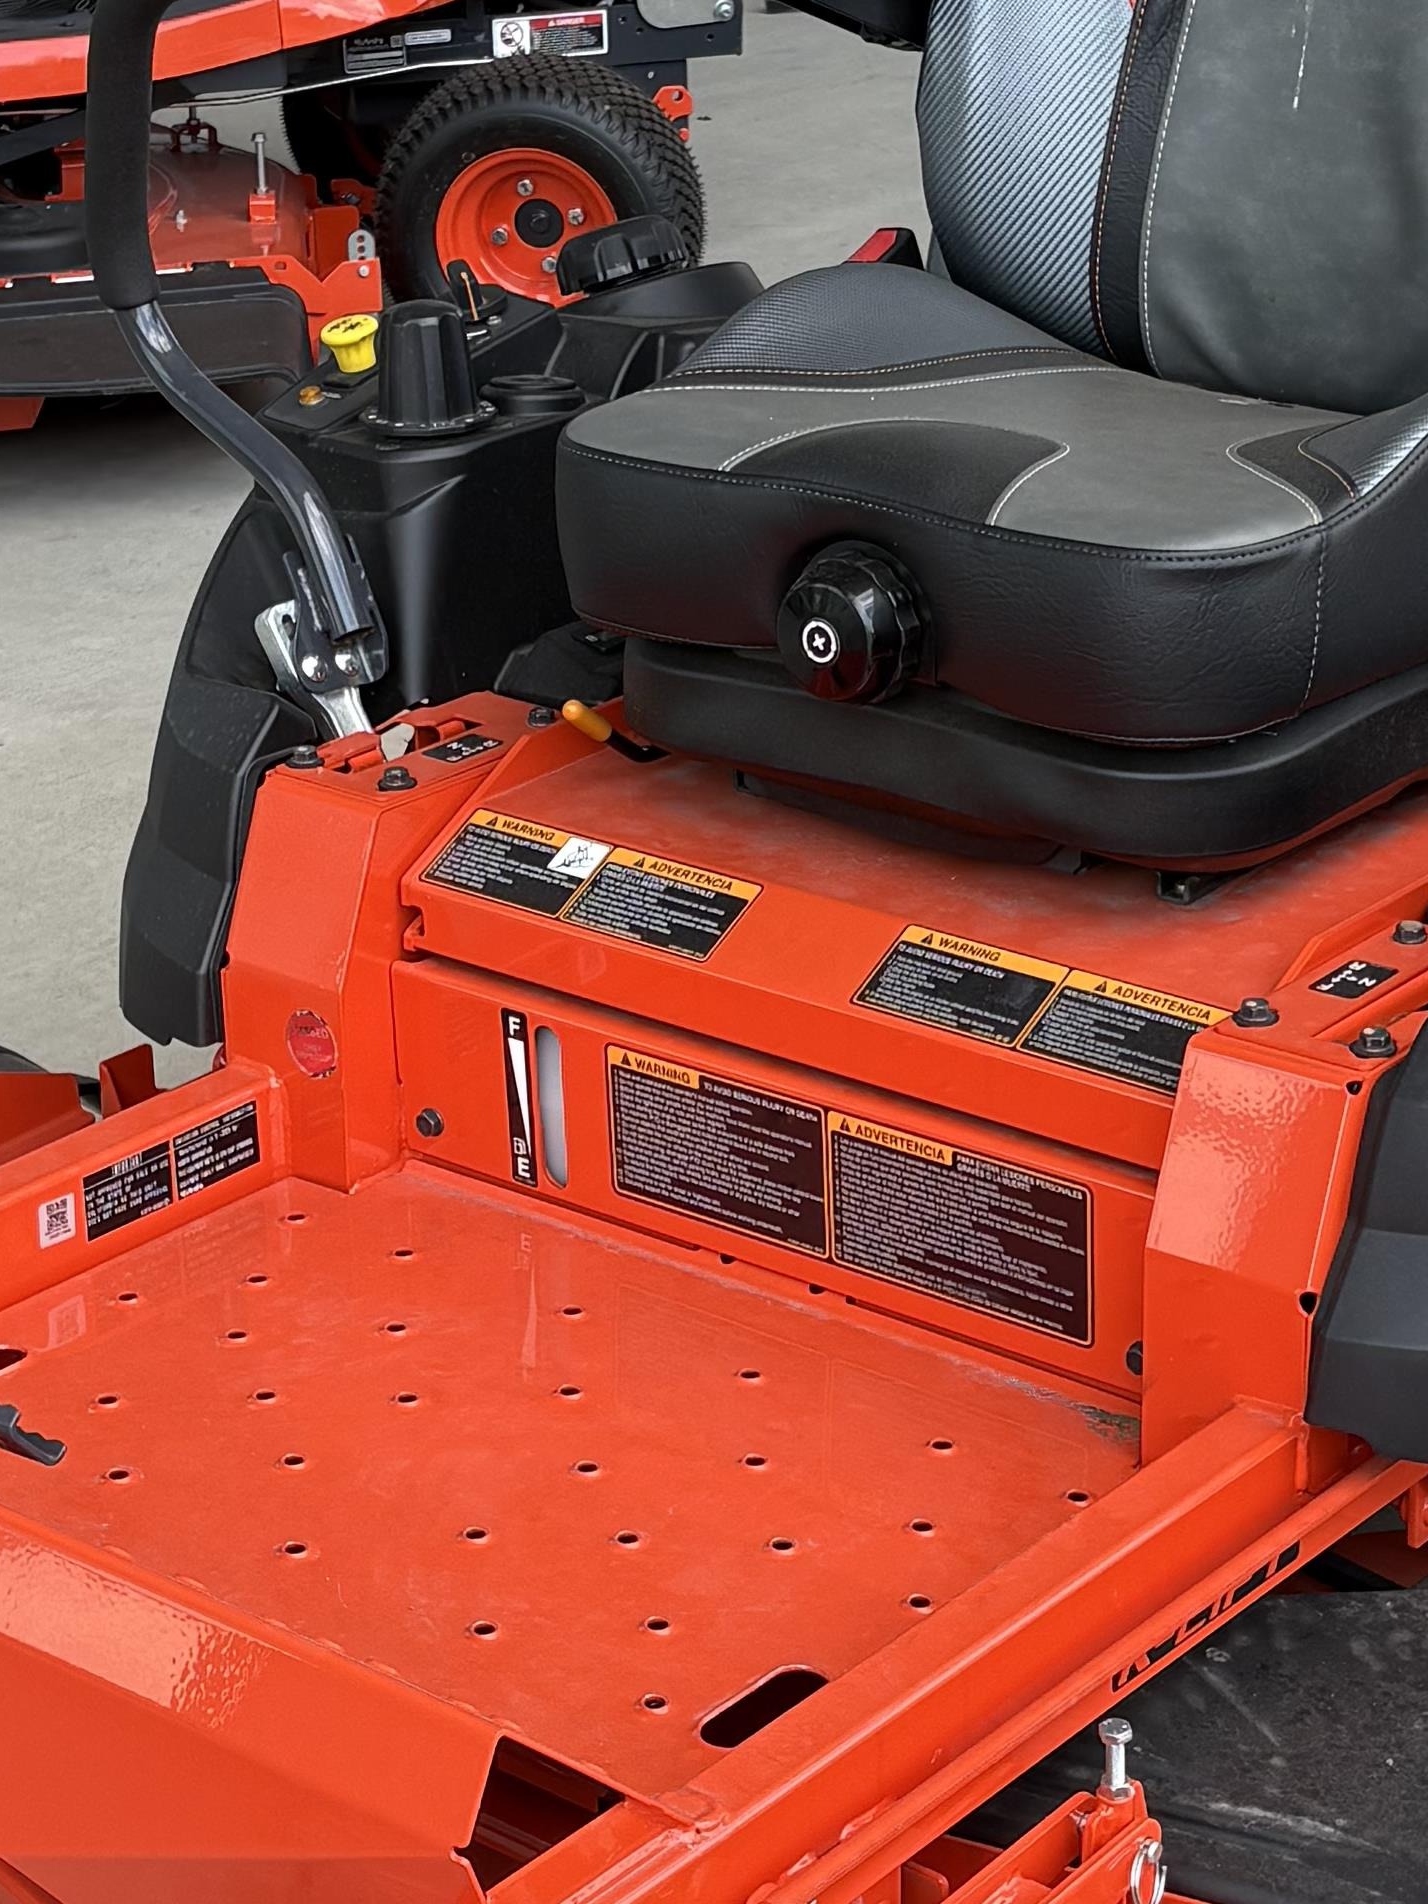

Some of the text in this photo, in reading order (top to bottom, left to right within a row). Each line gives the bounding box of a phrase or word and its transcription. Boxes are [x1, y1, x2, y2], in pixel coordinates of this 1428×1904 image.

[499, 819, 557, 842] WARNING
[646, 861, 735, 891] ADVERTENCIA
[935, 936, 1003, 962] WARNING
[1110, 985, 1213, 1021] ADVERTENCIA
[508, 1018, 521, 1039] F
[635, 1057, 691, 1084] WARNING
[855, 1123, 945, 1161] ADVERTENCIA
[517, 1157, 530, 1179] E
